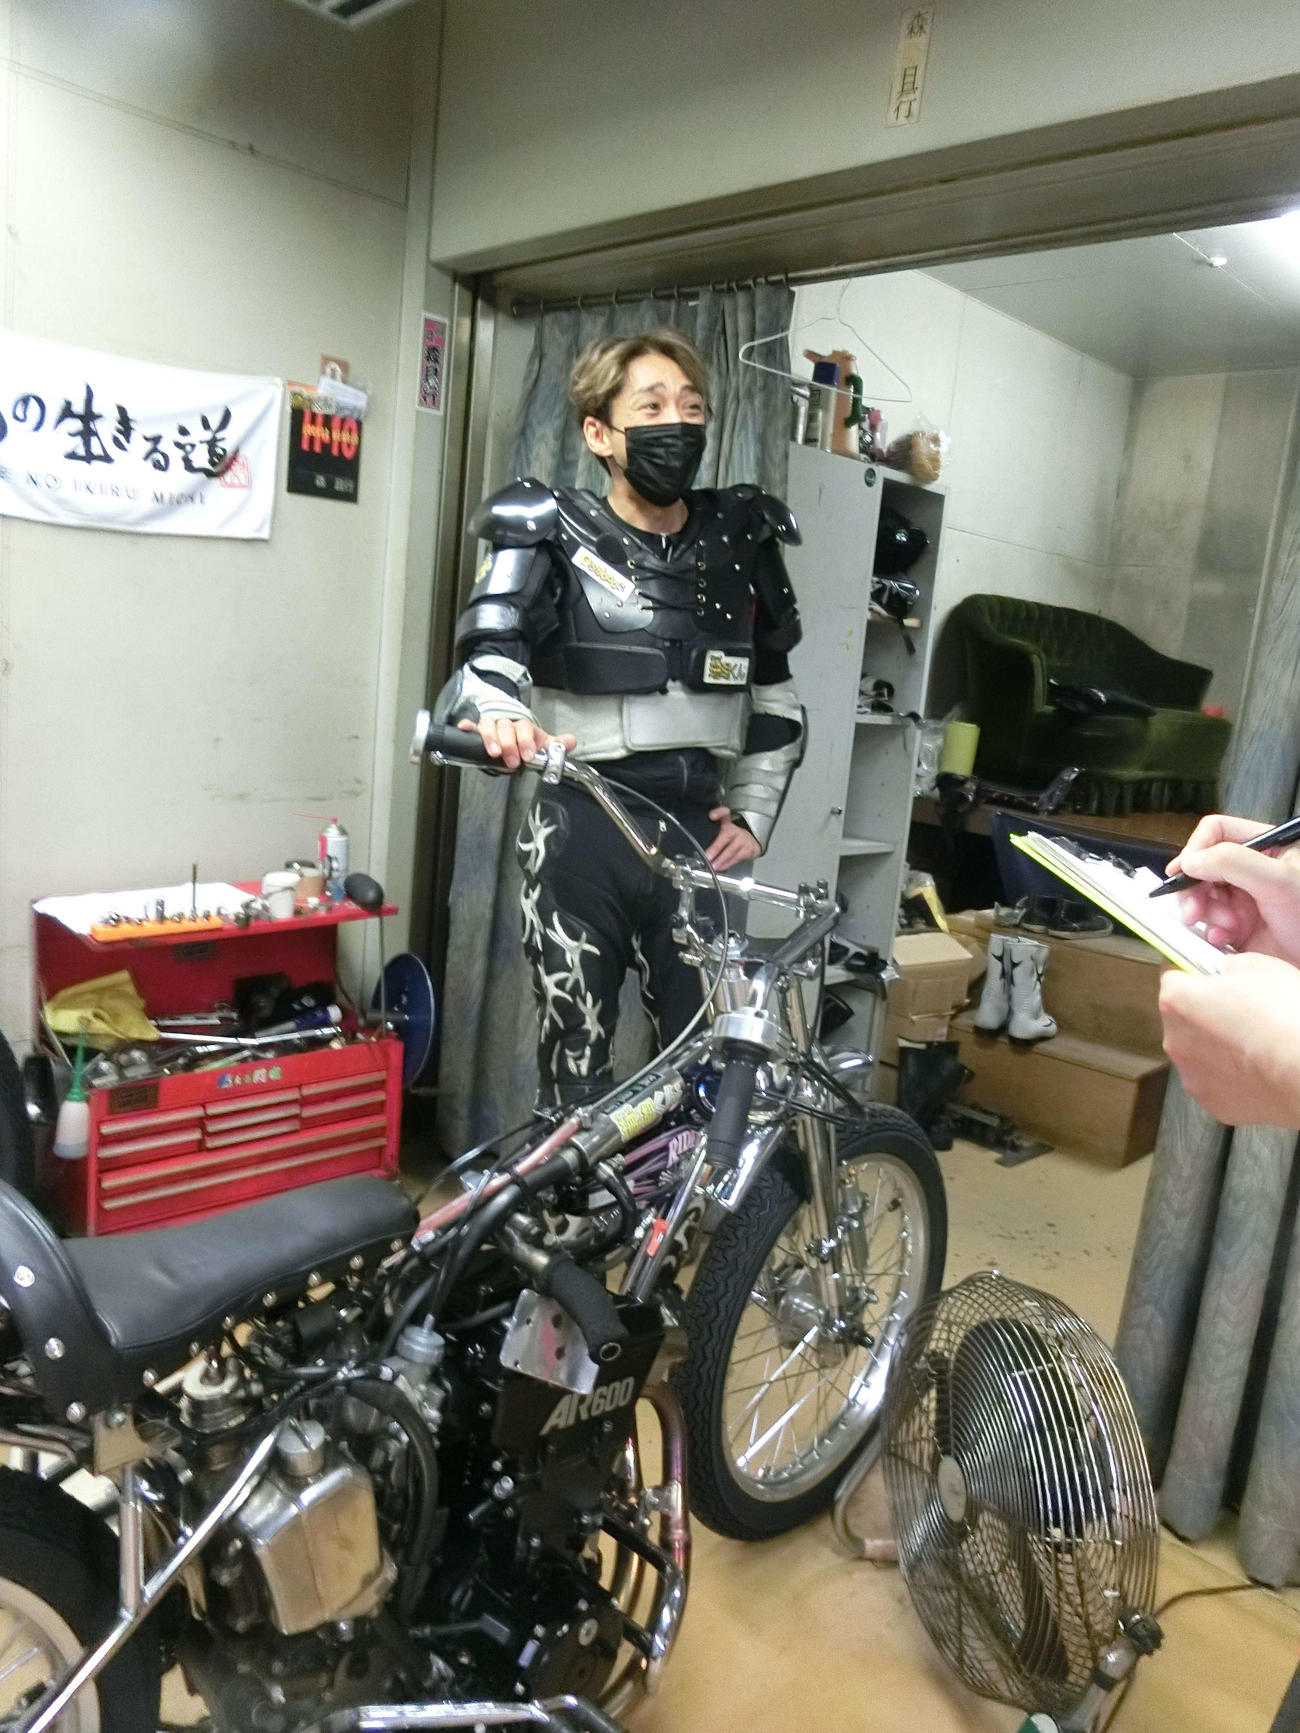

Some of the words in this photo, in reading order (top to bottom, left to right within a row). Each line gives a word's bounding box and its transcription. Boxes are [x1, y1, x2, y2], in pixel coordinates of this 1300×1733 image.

[0, 382, 240, 479] の生きる道
